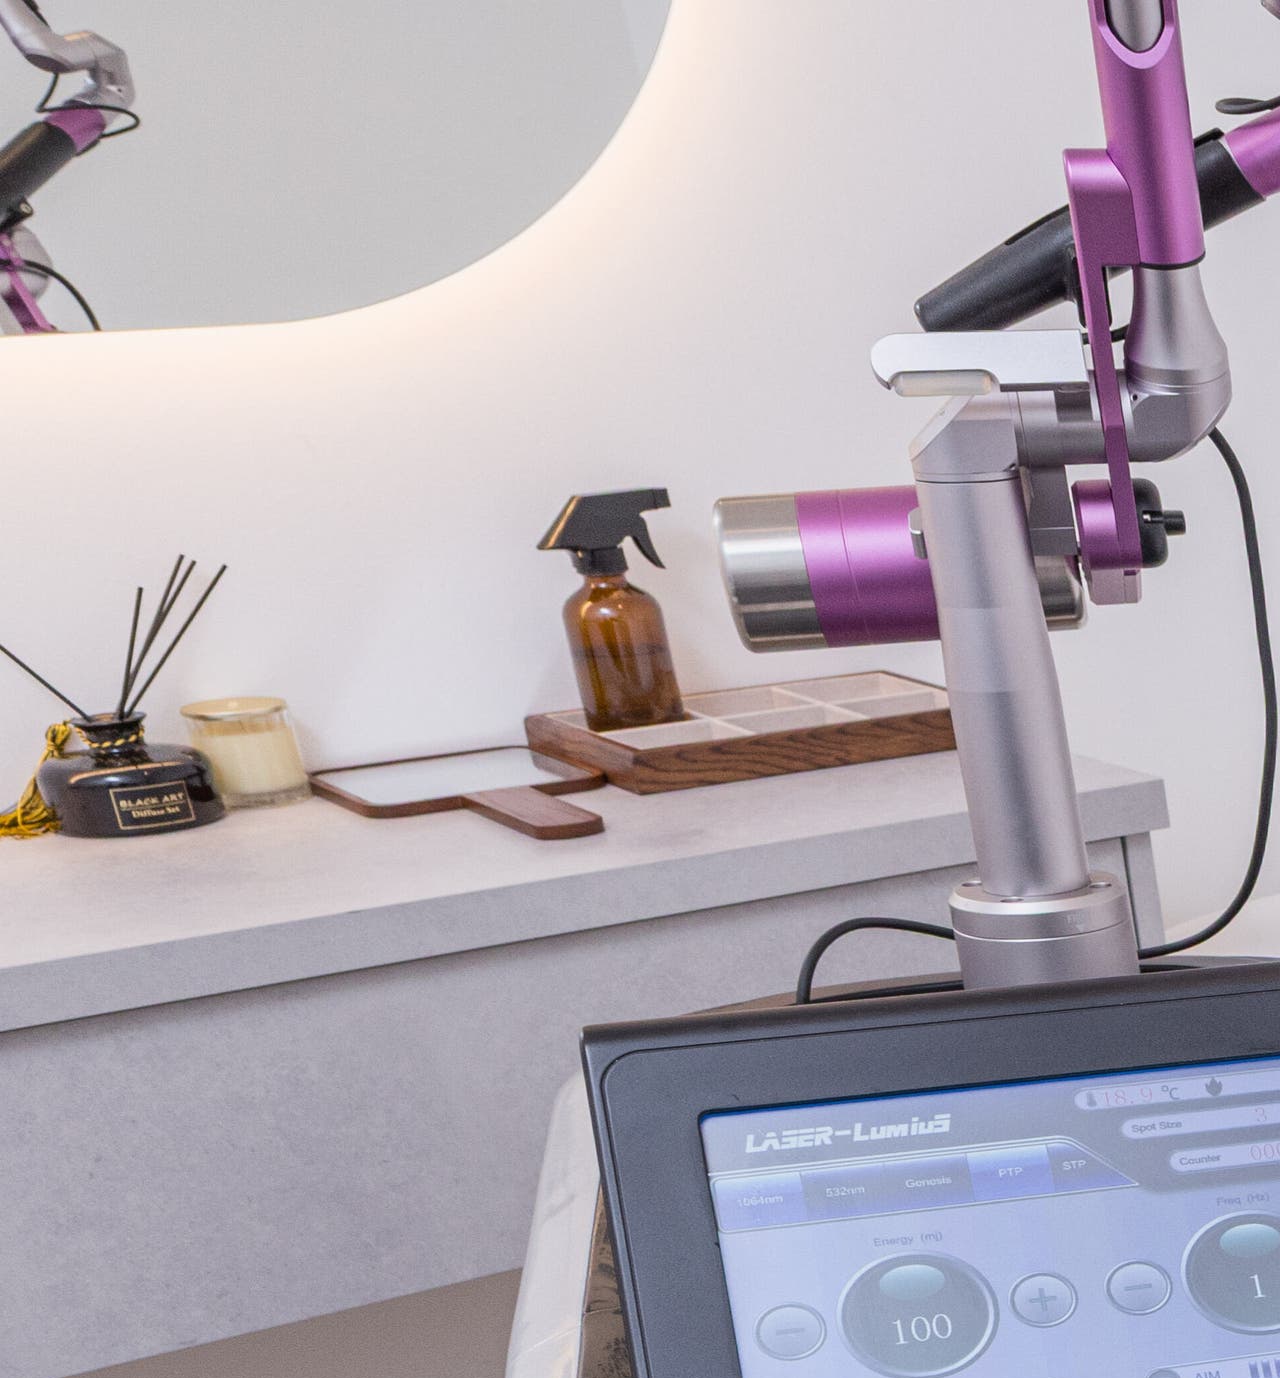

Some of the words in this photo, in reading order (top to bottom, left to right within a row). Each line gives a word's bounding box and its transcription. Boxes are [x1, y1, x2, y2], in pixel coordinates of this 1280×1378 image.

[119, 797, 159, 808] BLACK
[162, 792, 184, 803] ART
[166, 806, 181, 814] Set
[1254, 1107, 1268, 1123] 3
[1131, 1121, 1157, 1134] Spot
[1062, 1159, 1087, 1171] STP
[1179, 1153, 1222, 1167] Counter
[998, 1166, 1024, 1179] PTP
[905, 1175, 953, 1190] Genesis
[825, 1185, 866, 1198] 532nm
[873, 1234, 914, 1248] Energy
[1248, 1273, 1267, 1300] 1
[891, 1312, 953, 1346] 100
